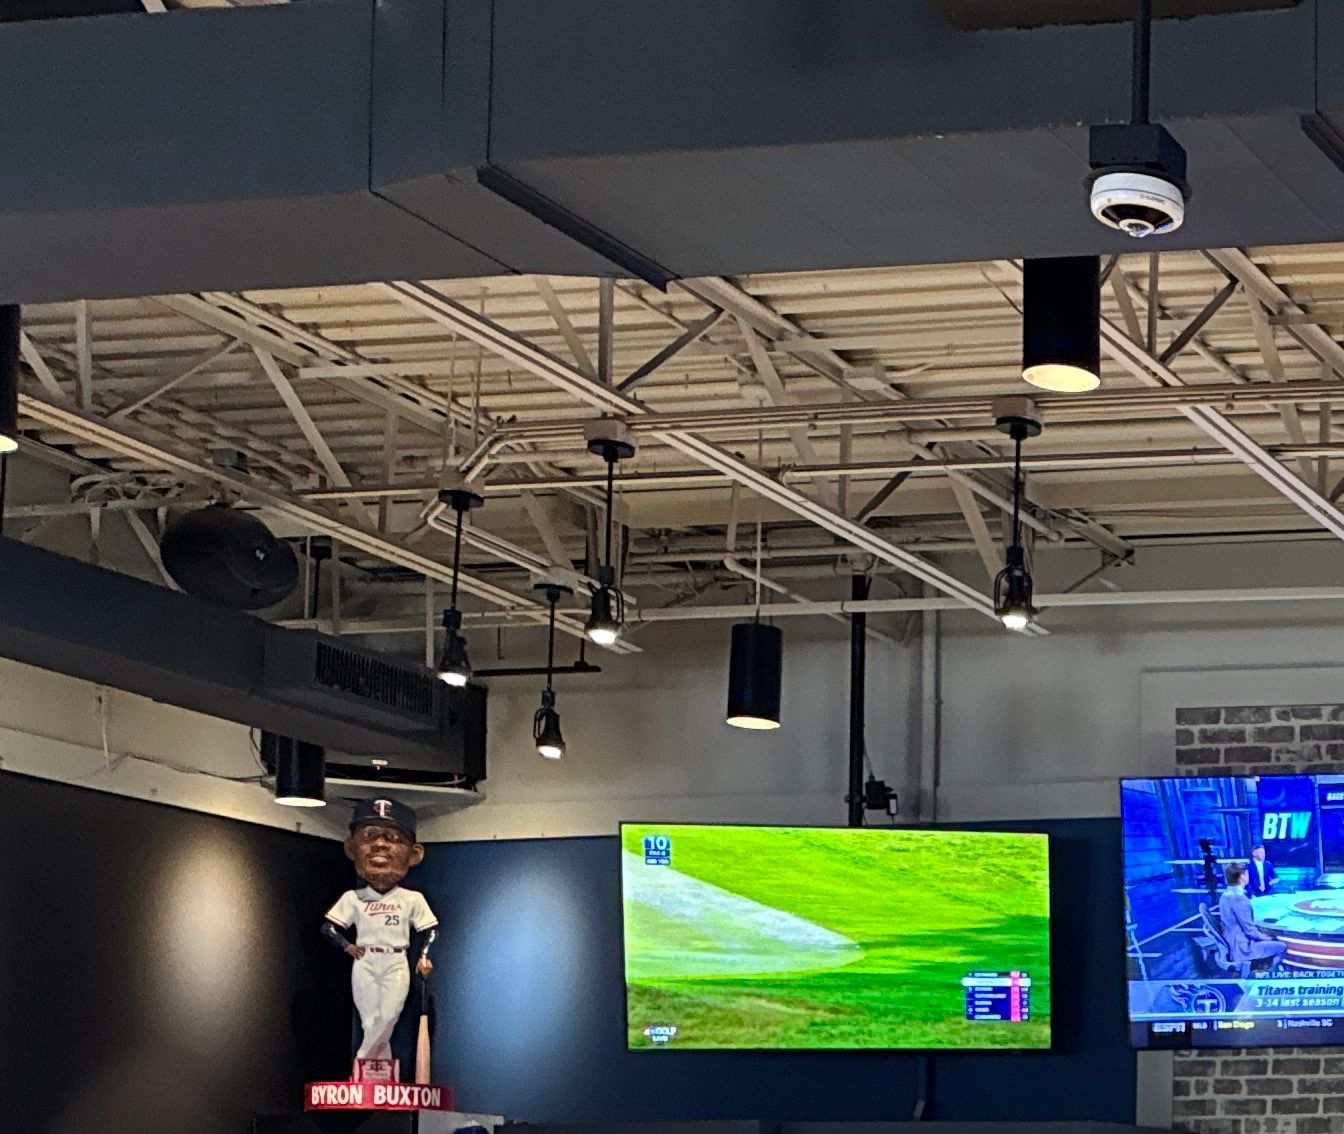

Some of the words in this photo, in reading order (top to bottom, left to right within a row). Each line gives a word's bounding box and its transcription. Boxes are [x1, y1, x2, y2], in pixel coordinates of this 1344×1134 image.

[1263, 812, 1312, 839] BTW
[648, 836, 667, 850] 10
[385, 915, 400, 927] 25
[1257, 985, 1295, 996] Titans
[1298, 984, 1343, 997] training
[1281, 997, 1300, 1006] last
[1302, 997, 1340, 1006] season
[311, 1085, 363, 1107] BYRON
[373, 1085, 441, 1107] BUXTON
